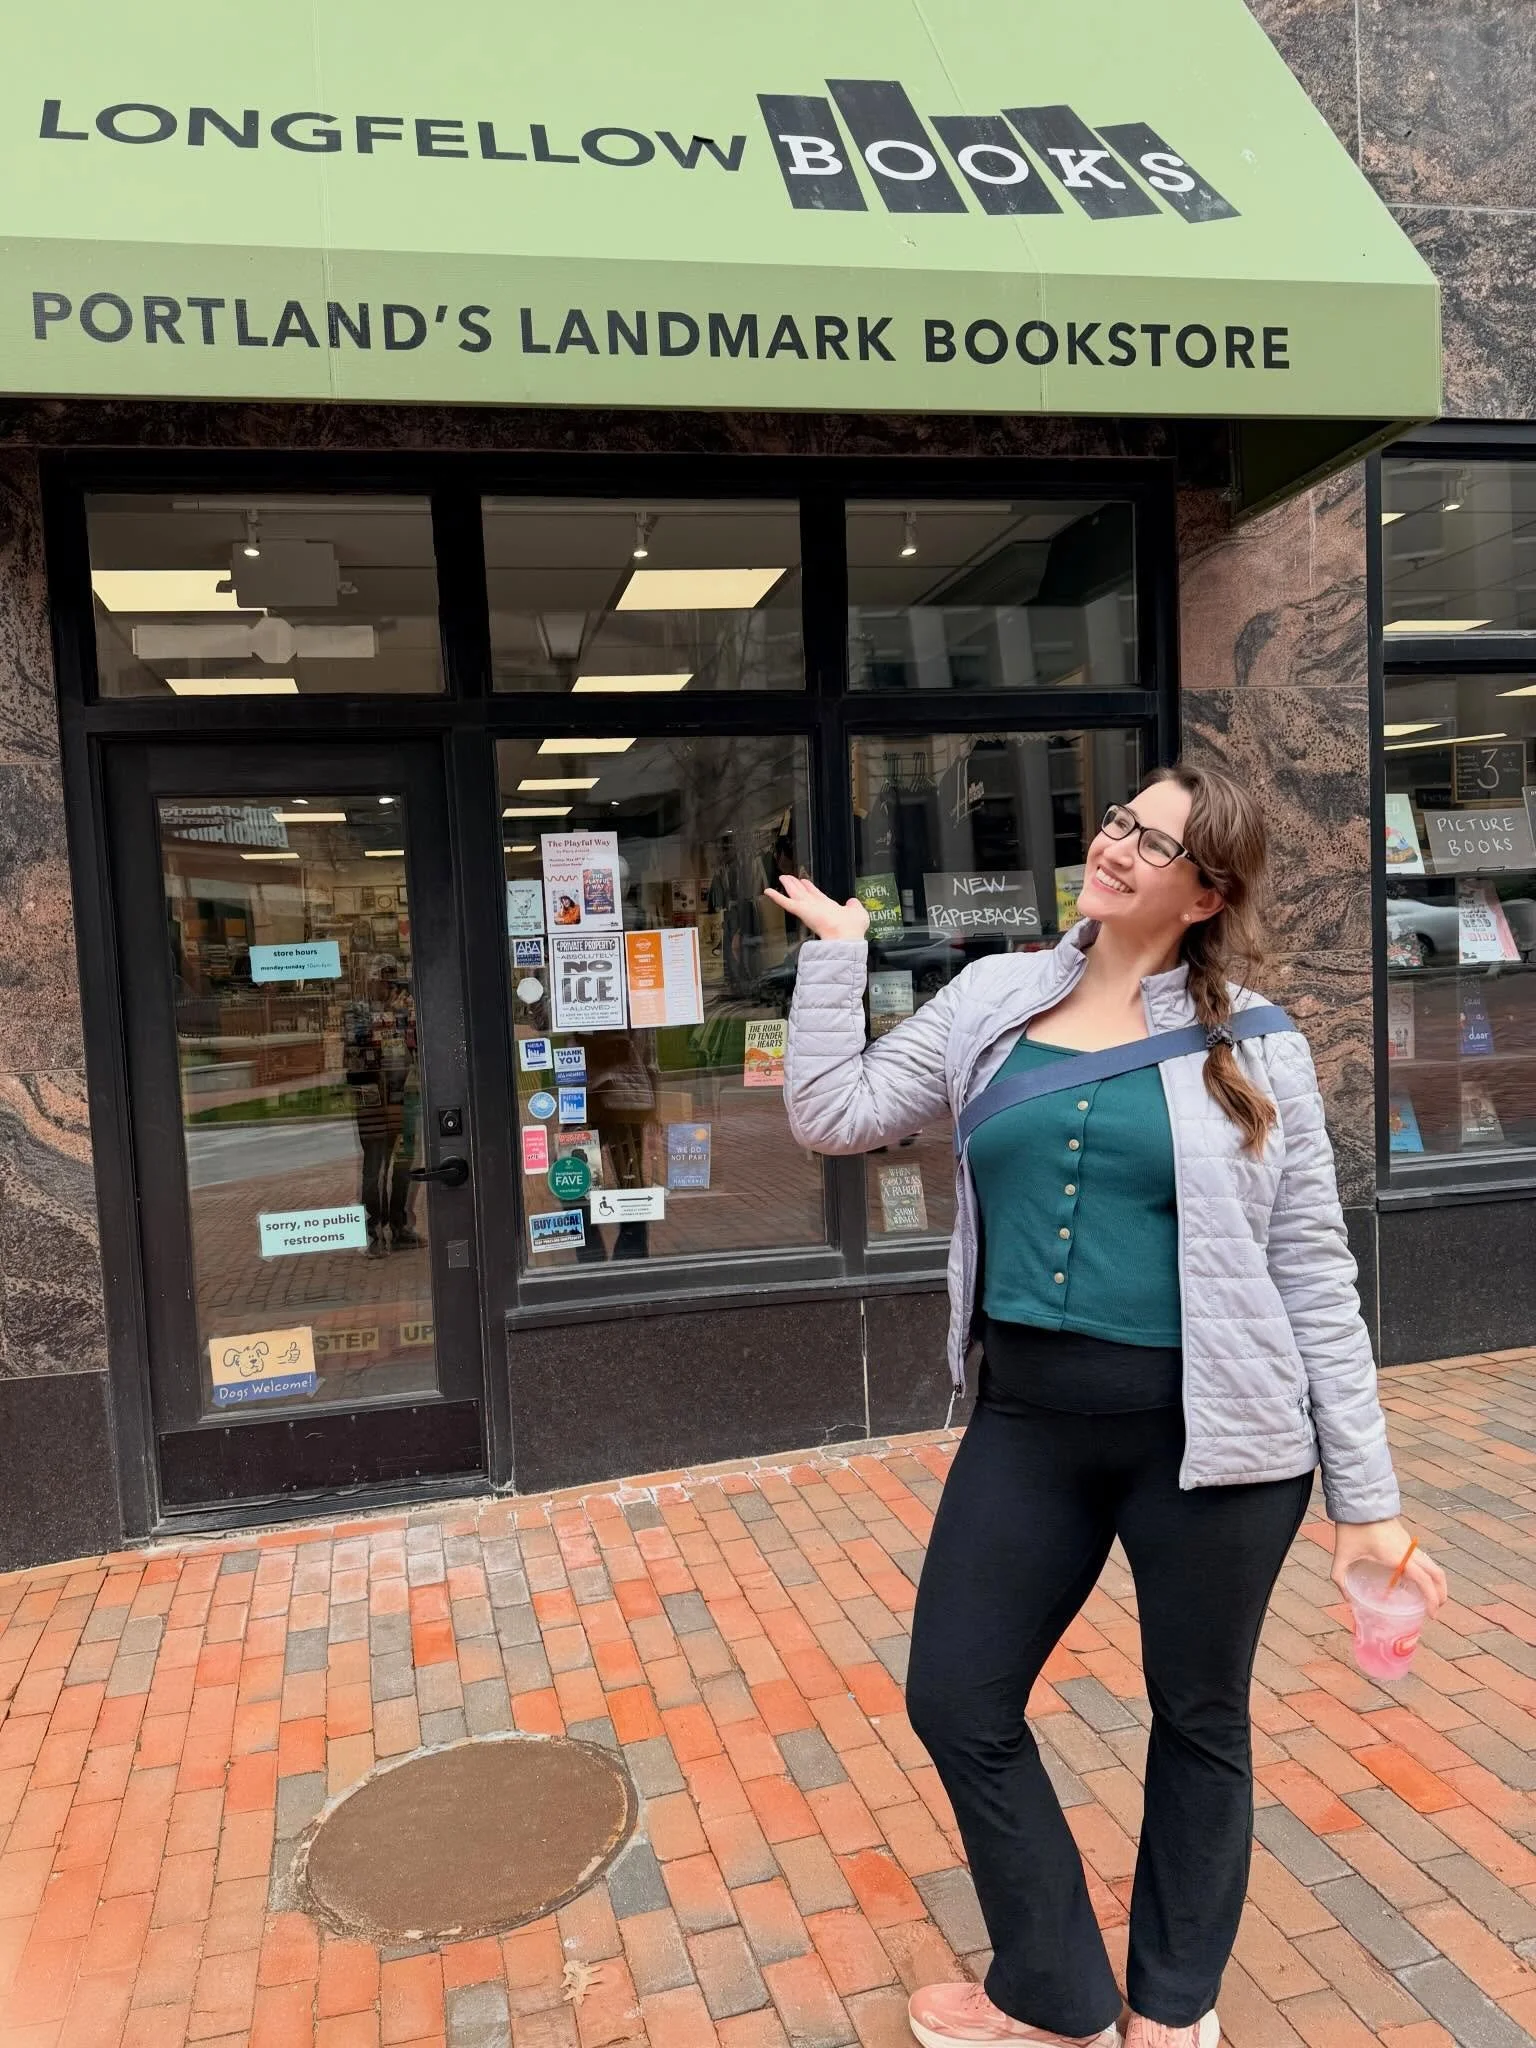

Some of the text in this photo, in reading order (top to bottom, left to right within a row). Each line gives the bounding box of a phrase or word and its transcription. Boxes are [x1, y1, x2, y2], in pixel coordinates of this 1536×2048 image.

[38, 98, 1196, 193] LONGFELLOW BOOKS
[31, 291, 1291, 371] PORTLAND'S LANDMARK BOOKSTORE
[1476, 748, 1500, 789] 3
[1436, 817, 1515, 832] PICTURE
[564, 840, 593, 848] Playful
[594, 839, 611, 848] Way
[1447, 838, 1513, 856] BOOKS
[865, 886, 890, 897] OPEN,
[953, 875, 1005, 896] NEW
[927, 904, 1038, 928] PAPERBACKS
[517, 941, 541, 953] ABA
[560, 939, 613, 952] PRIVATE PROPERTY
[563, 960, 613, 973] NO
[569, 1004, 611, 1012] ALLOWED
[749, 1024, 782, 1033] THE ROAD
[757, 1032, 783, 1040] TENDER
[757, 1040, 783, 1048] HEARTS
[555, 1049, 583, 1057] THANK
[559, 1056, 581, 1064] YOU
[555, 1175, 583, 1186] FAVE
[265, 1213, 361, 1232] sorry, no public
[533, 1216, 580, 1231] BUY LOCAL
[283, 1232, 345, 1246] restrooms
[315, 1324, 433, 1350] STEP UP
[219, 1375, 313, 1401] Dogs Welcome!
